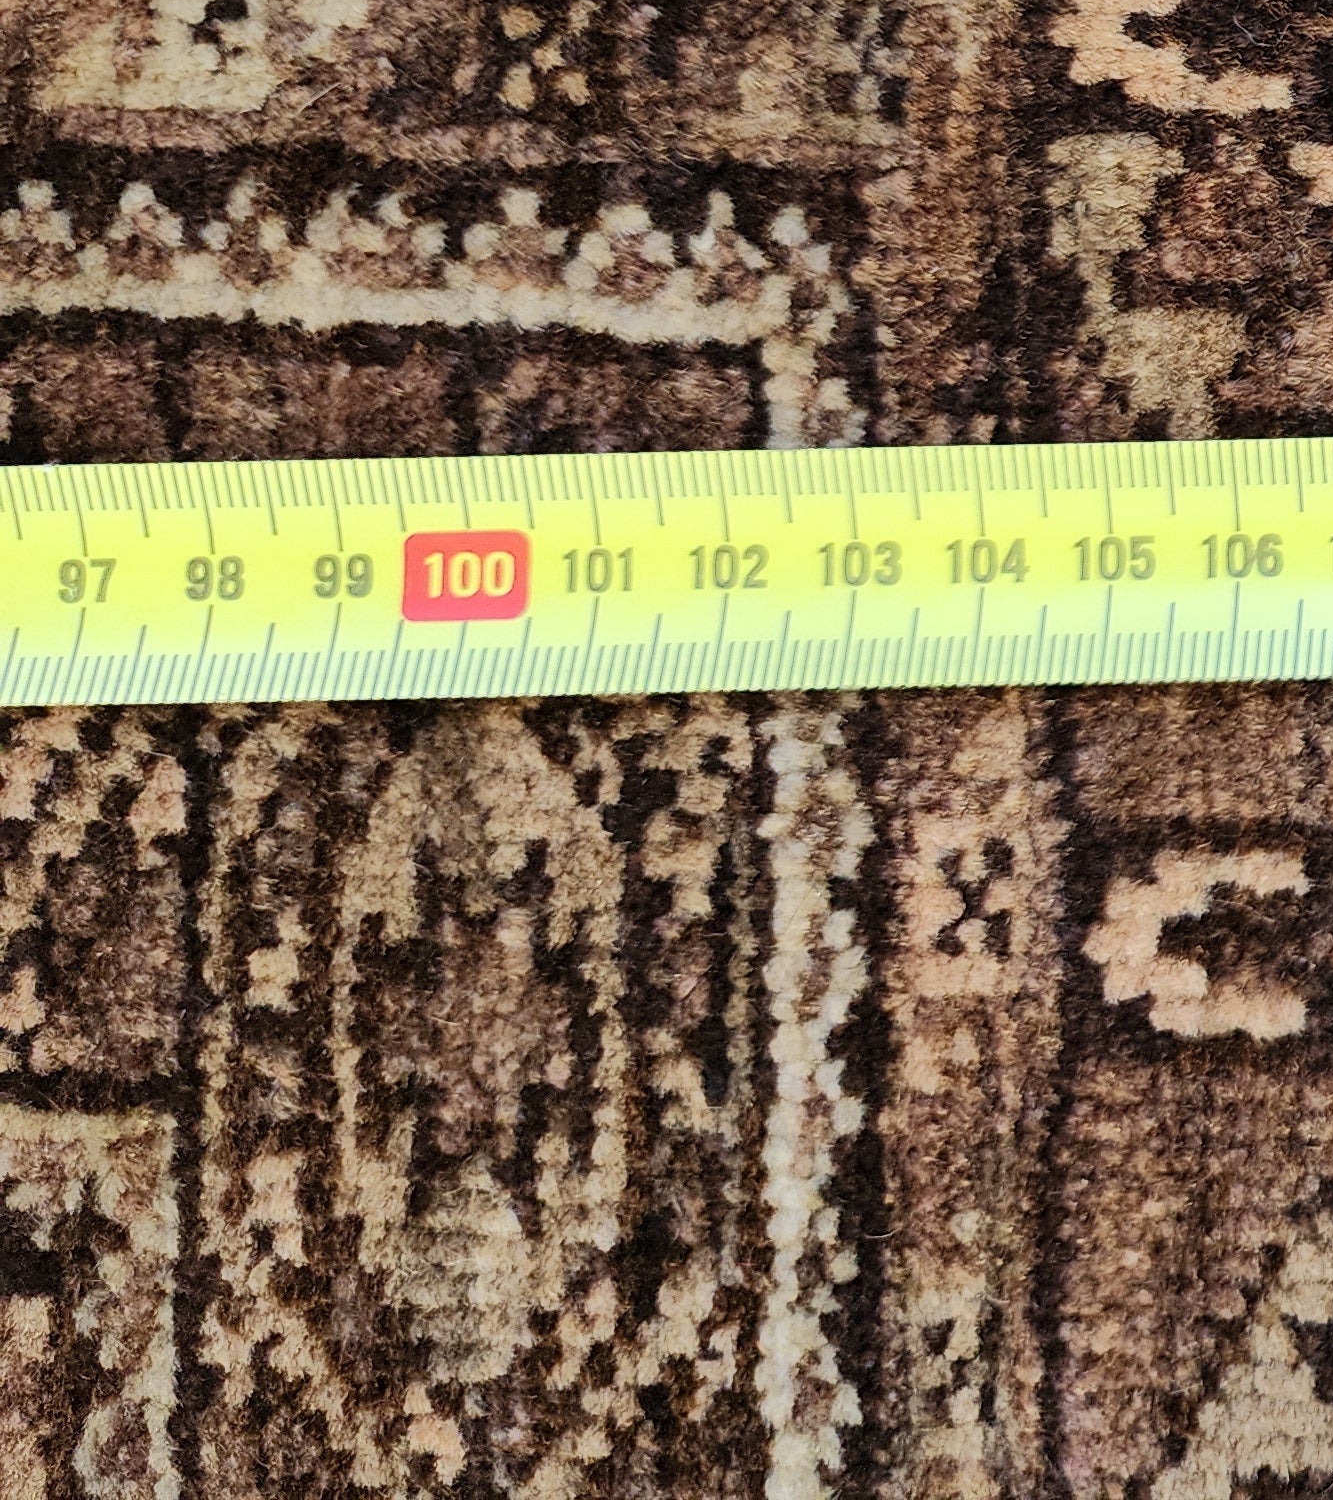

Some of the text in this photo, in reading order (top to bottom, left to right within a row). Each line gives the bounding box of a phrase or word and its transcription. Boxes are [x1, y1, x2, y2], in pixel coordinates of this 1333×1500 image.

[57, 557, 118, 604] 97
[185, 555, 246, 602] 98
[312, 553, 374, 600] 99
[423, 550, 517, 600] 100
[562, 548, 635, 593] 101
[689, 544, 769, 590] 102
[818, 540, 903, 588] 103
[946, 538, 1030, 584] 104
[1073, 535, 1157, 582] 105
[1201, 533, 1285, 579] 106
